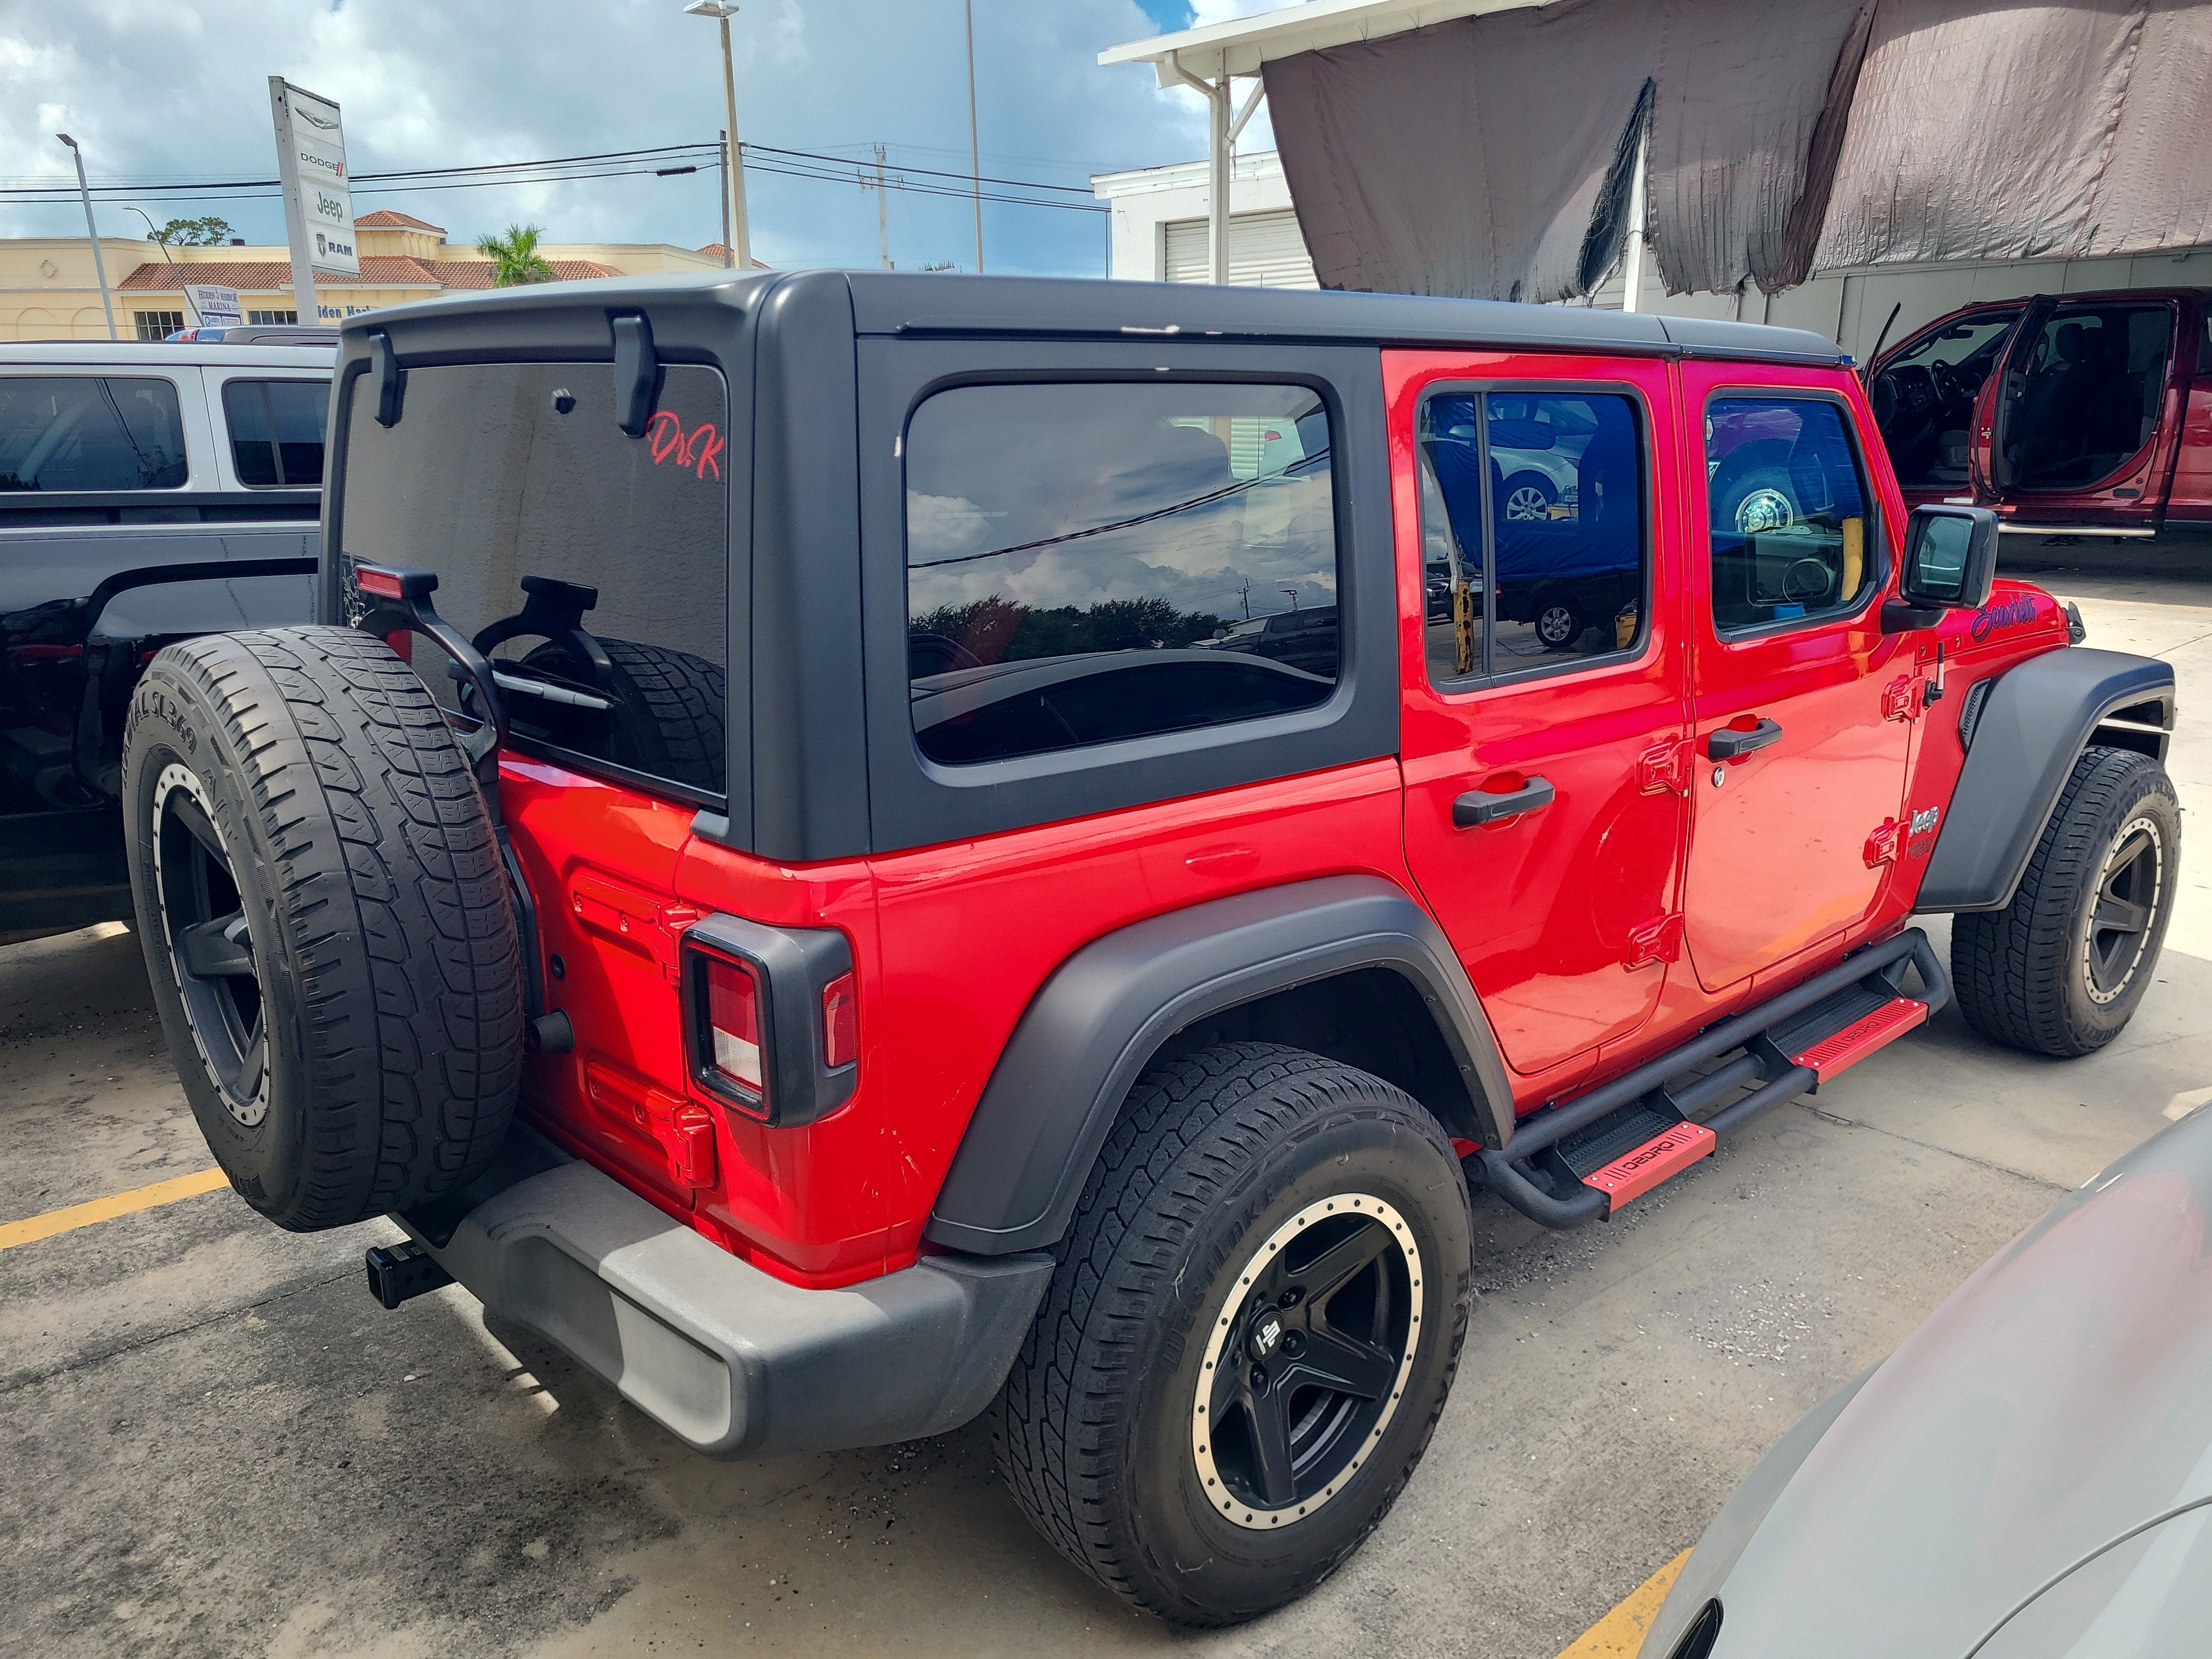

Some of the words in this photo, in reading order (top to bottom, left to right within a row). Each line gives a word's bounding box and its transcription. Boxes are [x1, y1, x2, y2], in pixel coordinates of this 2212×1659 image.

[301, 152, 338, 171] DODGE
[317, 190, 343, 223] Jeep
[328, 241, 353, 257] RAM
[198, 289, 215, 300] HIDDEN
[221, 292, 238, 303] HARBOR
[208, 301, 232, 312] MARINA
[151, 691, 198, 755] SL369
[1908, 806, 1940, 838] Jeep
